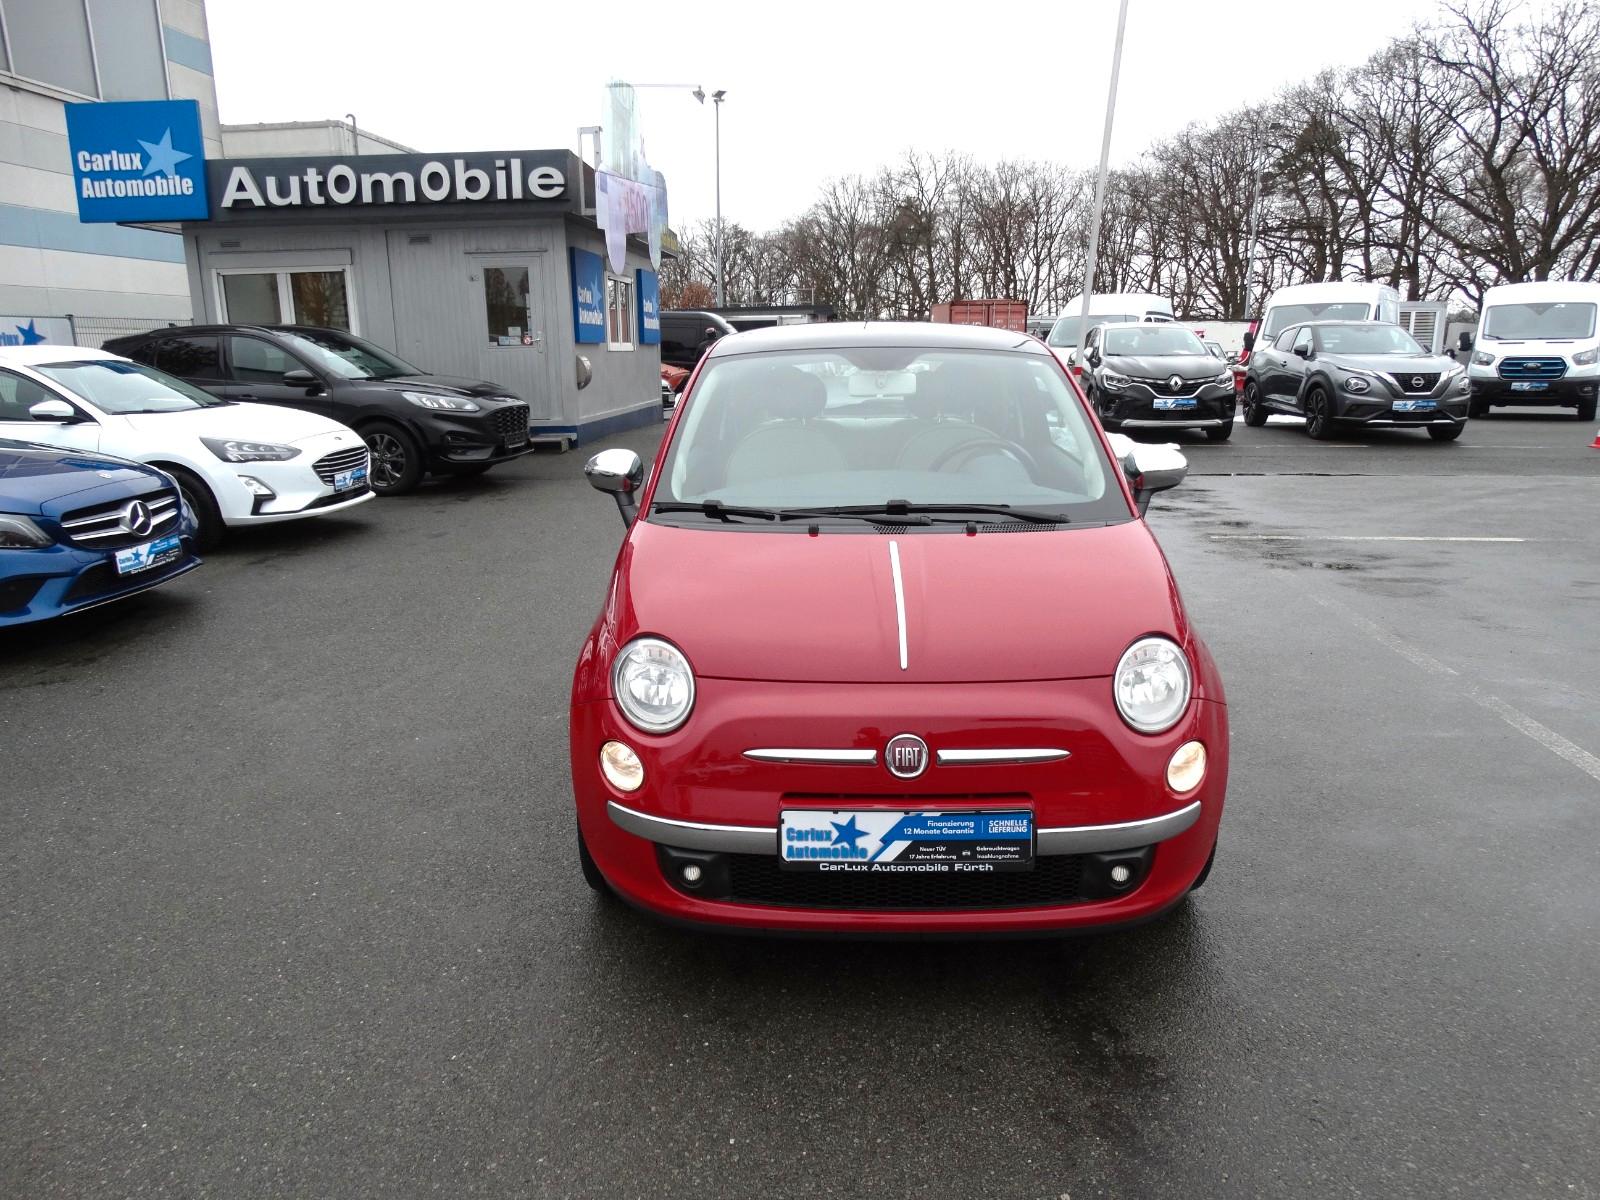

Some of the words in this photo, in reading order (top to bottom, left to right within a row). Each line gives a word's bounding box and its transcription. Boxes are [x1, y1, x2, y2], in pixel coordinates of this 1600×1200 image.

[77, 149, 143, 172] Carlux
[81, 174, 194, 199] Automobile
[895, 747, 920, 767] FIAT
[927, 820, 975, 828] Finanzierung
[988, 819, 1028, 827] SCHNELLE
[786, 828, 832, 841] Carlux
[819, 863, 868, 871] CarLux
[871, 863, 949, 872] Automobile
[954, 863, 993, 871] Fürth
